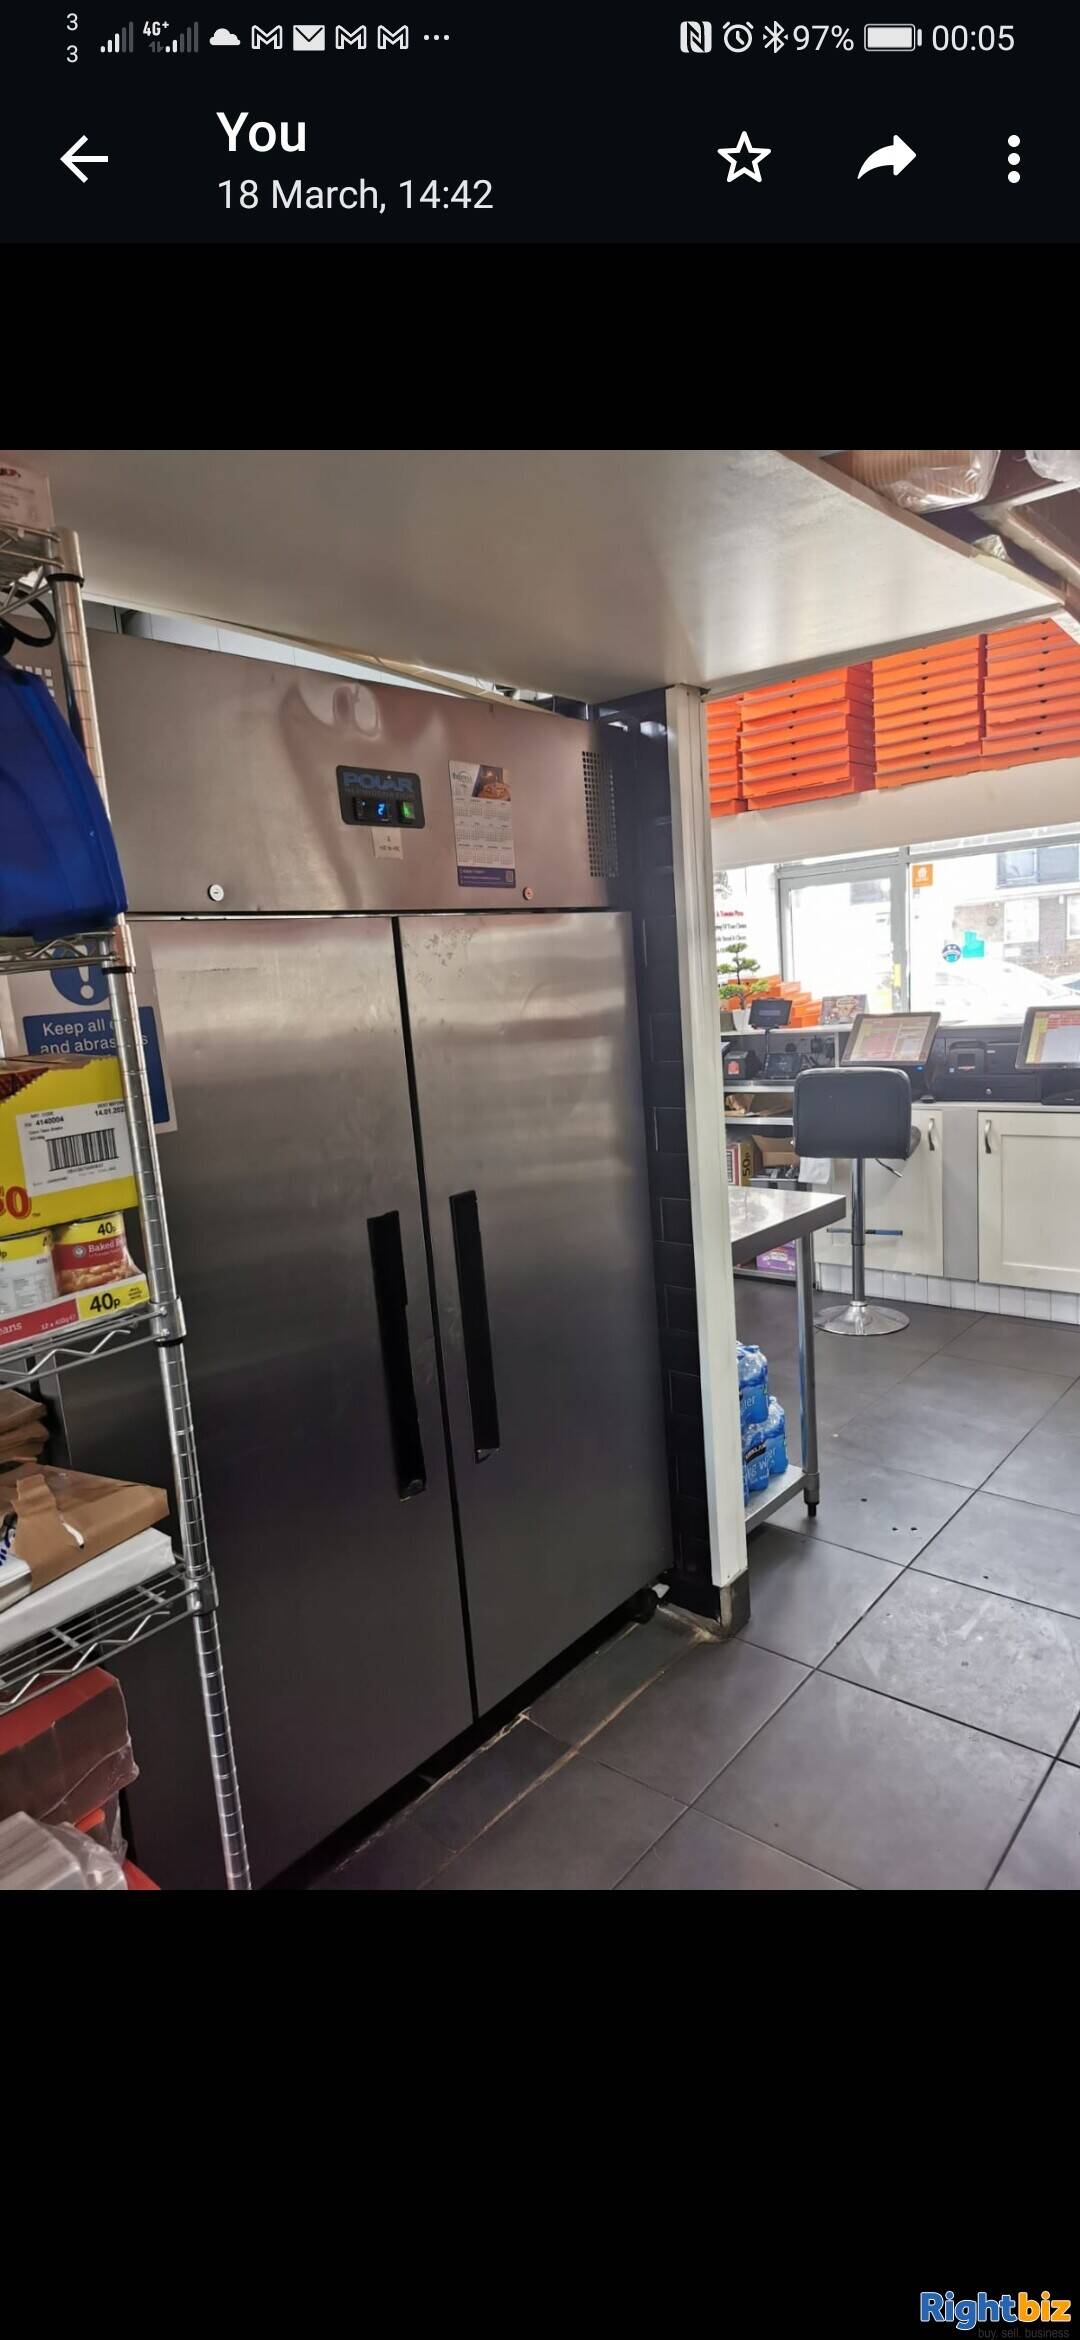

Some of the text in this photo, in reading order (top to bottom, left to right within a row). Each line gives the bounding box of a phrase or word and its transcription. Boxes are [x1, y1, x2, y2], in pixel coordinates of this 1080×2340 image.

[342, 771, 415, 793] POLAR
[43, 1021, 84, 1037] Keep
[88, 1018, 106, 1032] all
[41, 1040, 73, 1055] and
[88, 1239, 115, 1253] Baked
[89, 1292, 121, 1313] 40p
